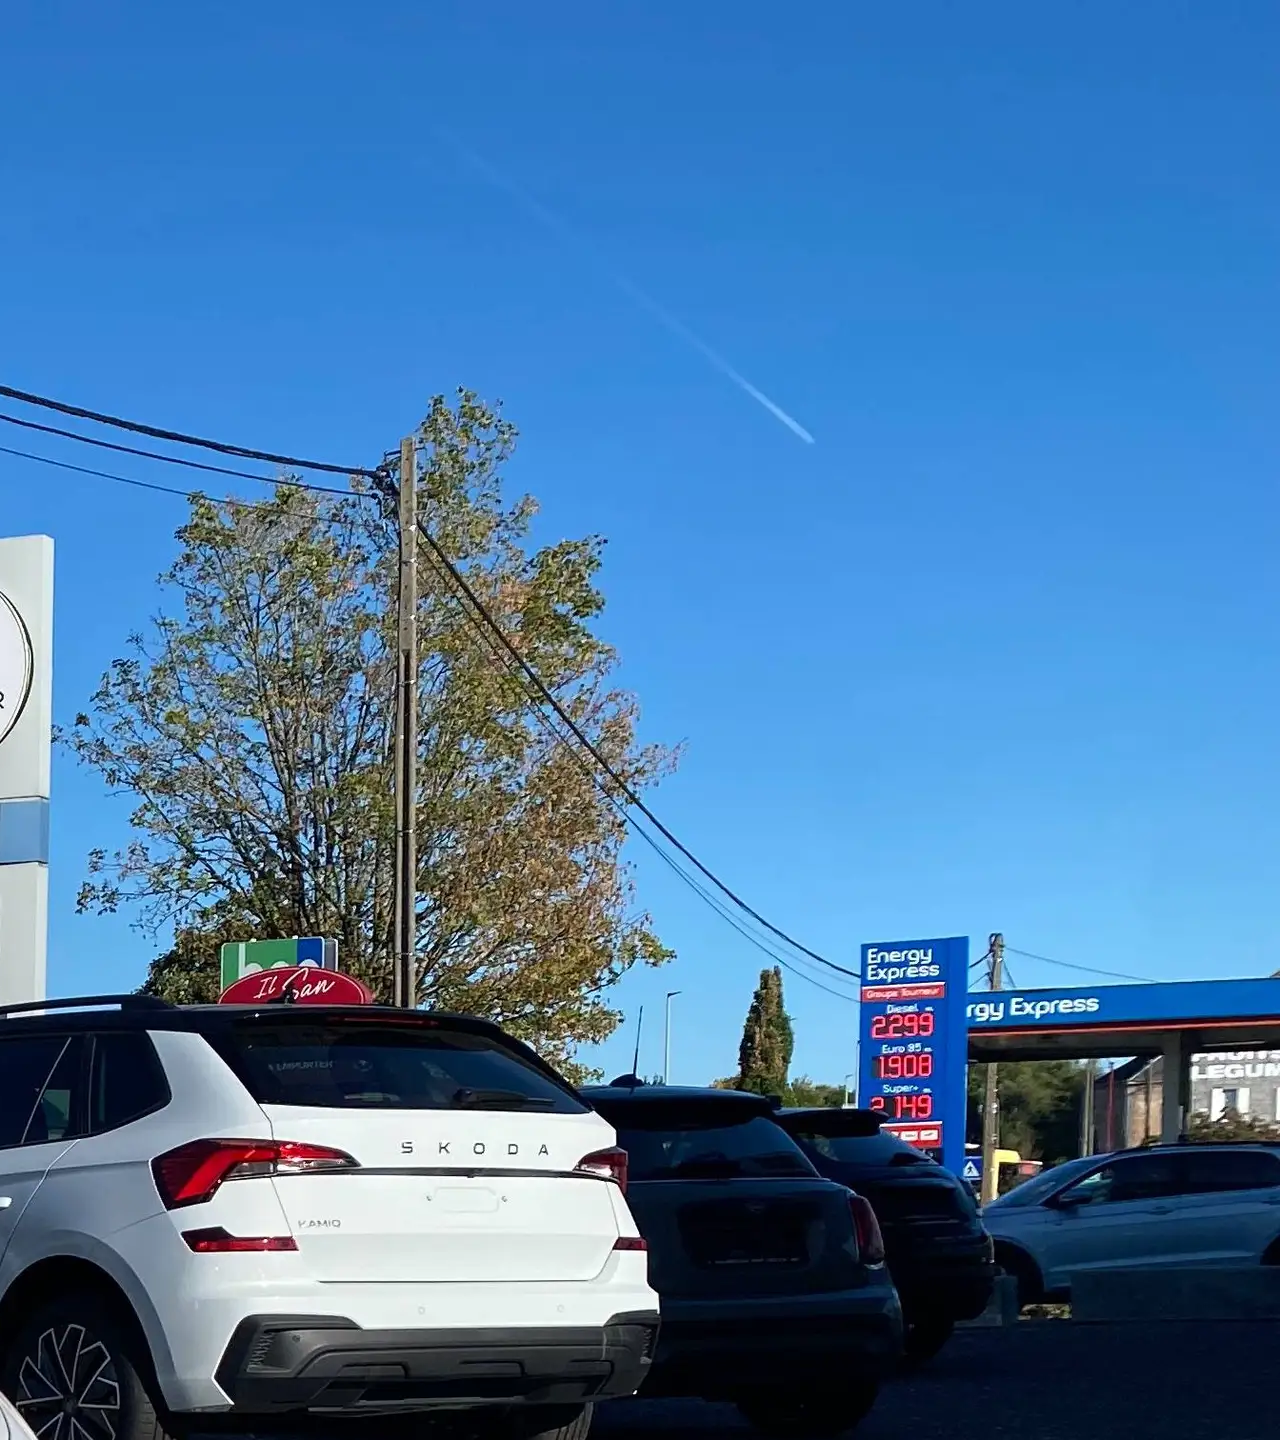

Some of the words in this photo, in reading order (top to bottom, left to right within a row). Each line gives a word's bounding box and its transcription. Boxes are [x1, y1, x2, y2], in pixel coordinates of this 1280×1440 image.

[867, 948, 933, 966] Energy
[867, 965, 940, 983] Express
[886, 1004, 919, 1014] Diesel
[1010, 997, 1100, 1020] Express
[882, 1044, 905, 1054] Euro
[883, 1084, 919, 1094] Super+
[400, 1141, 549, 1156] SKODA
